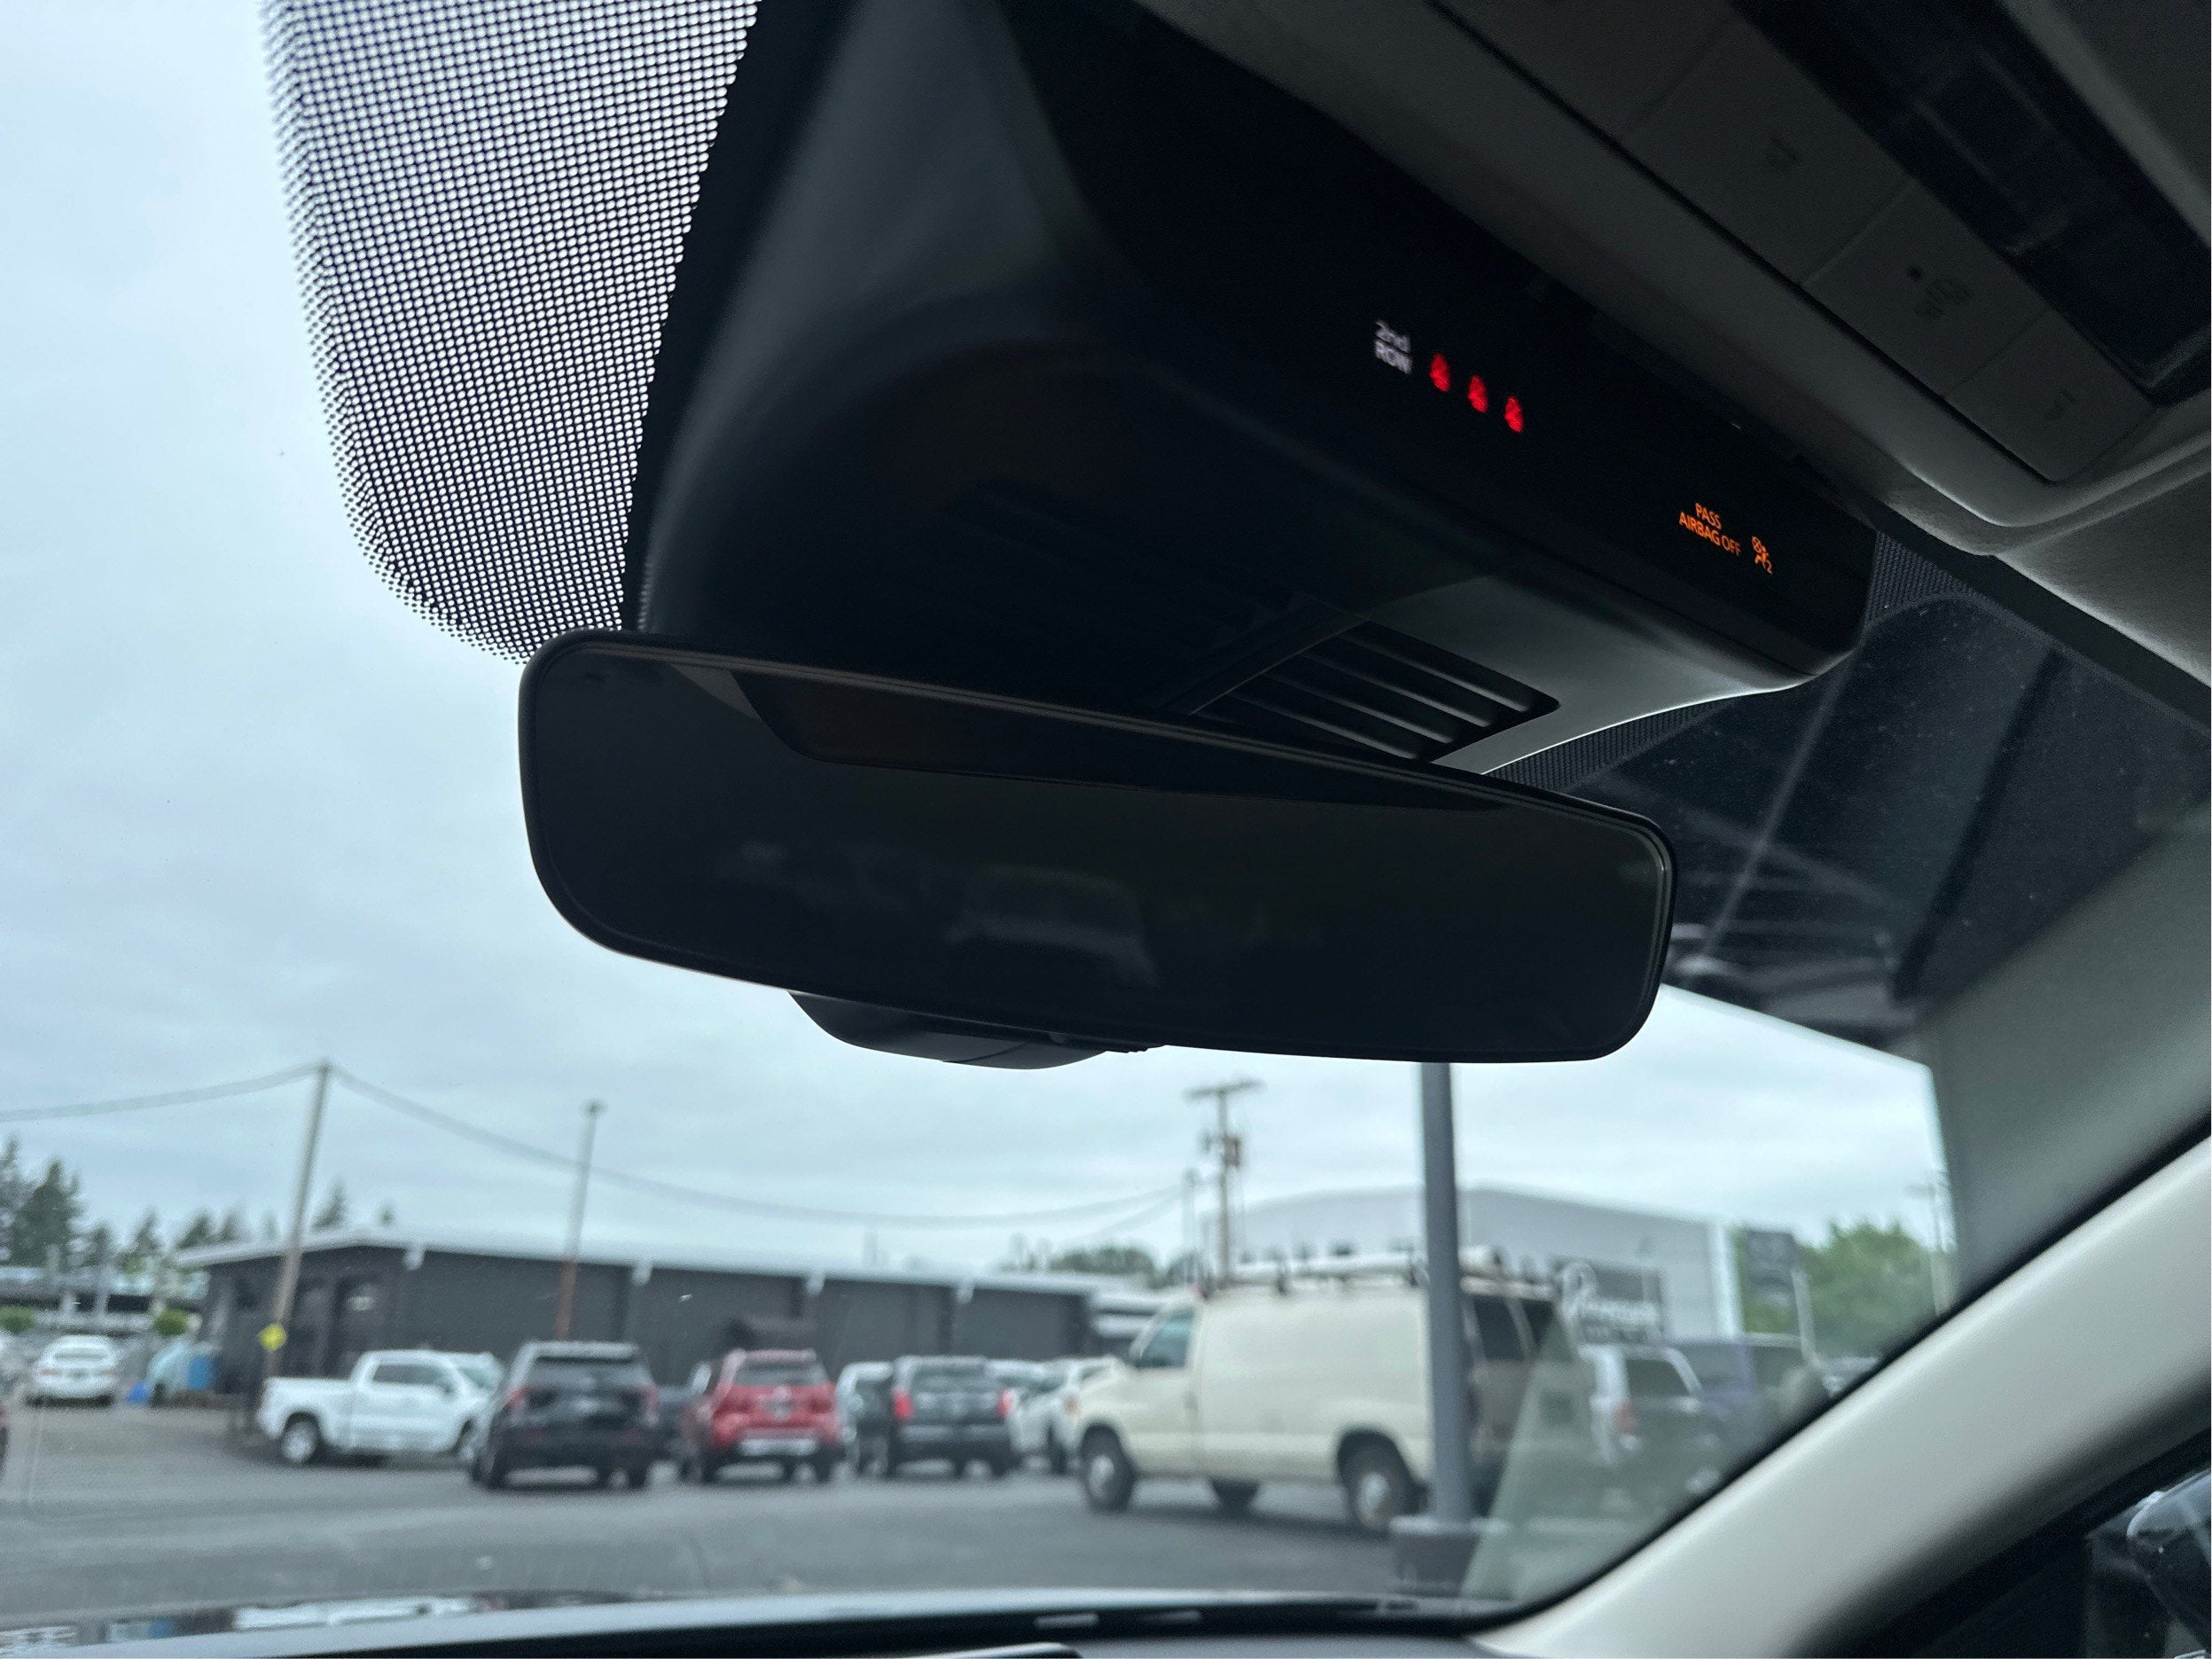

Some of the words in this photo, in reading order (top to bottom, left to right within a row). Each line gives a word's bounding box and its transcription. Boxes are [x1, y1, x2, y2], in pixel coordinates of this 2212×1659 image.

[1375, 340, 1412, 374] ROW
[1695, 503, 1721, 529] PASS
[1679, 512, 1721, 546] AIRBAG
[1721, 535, 1741, 556] OFF
